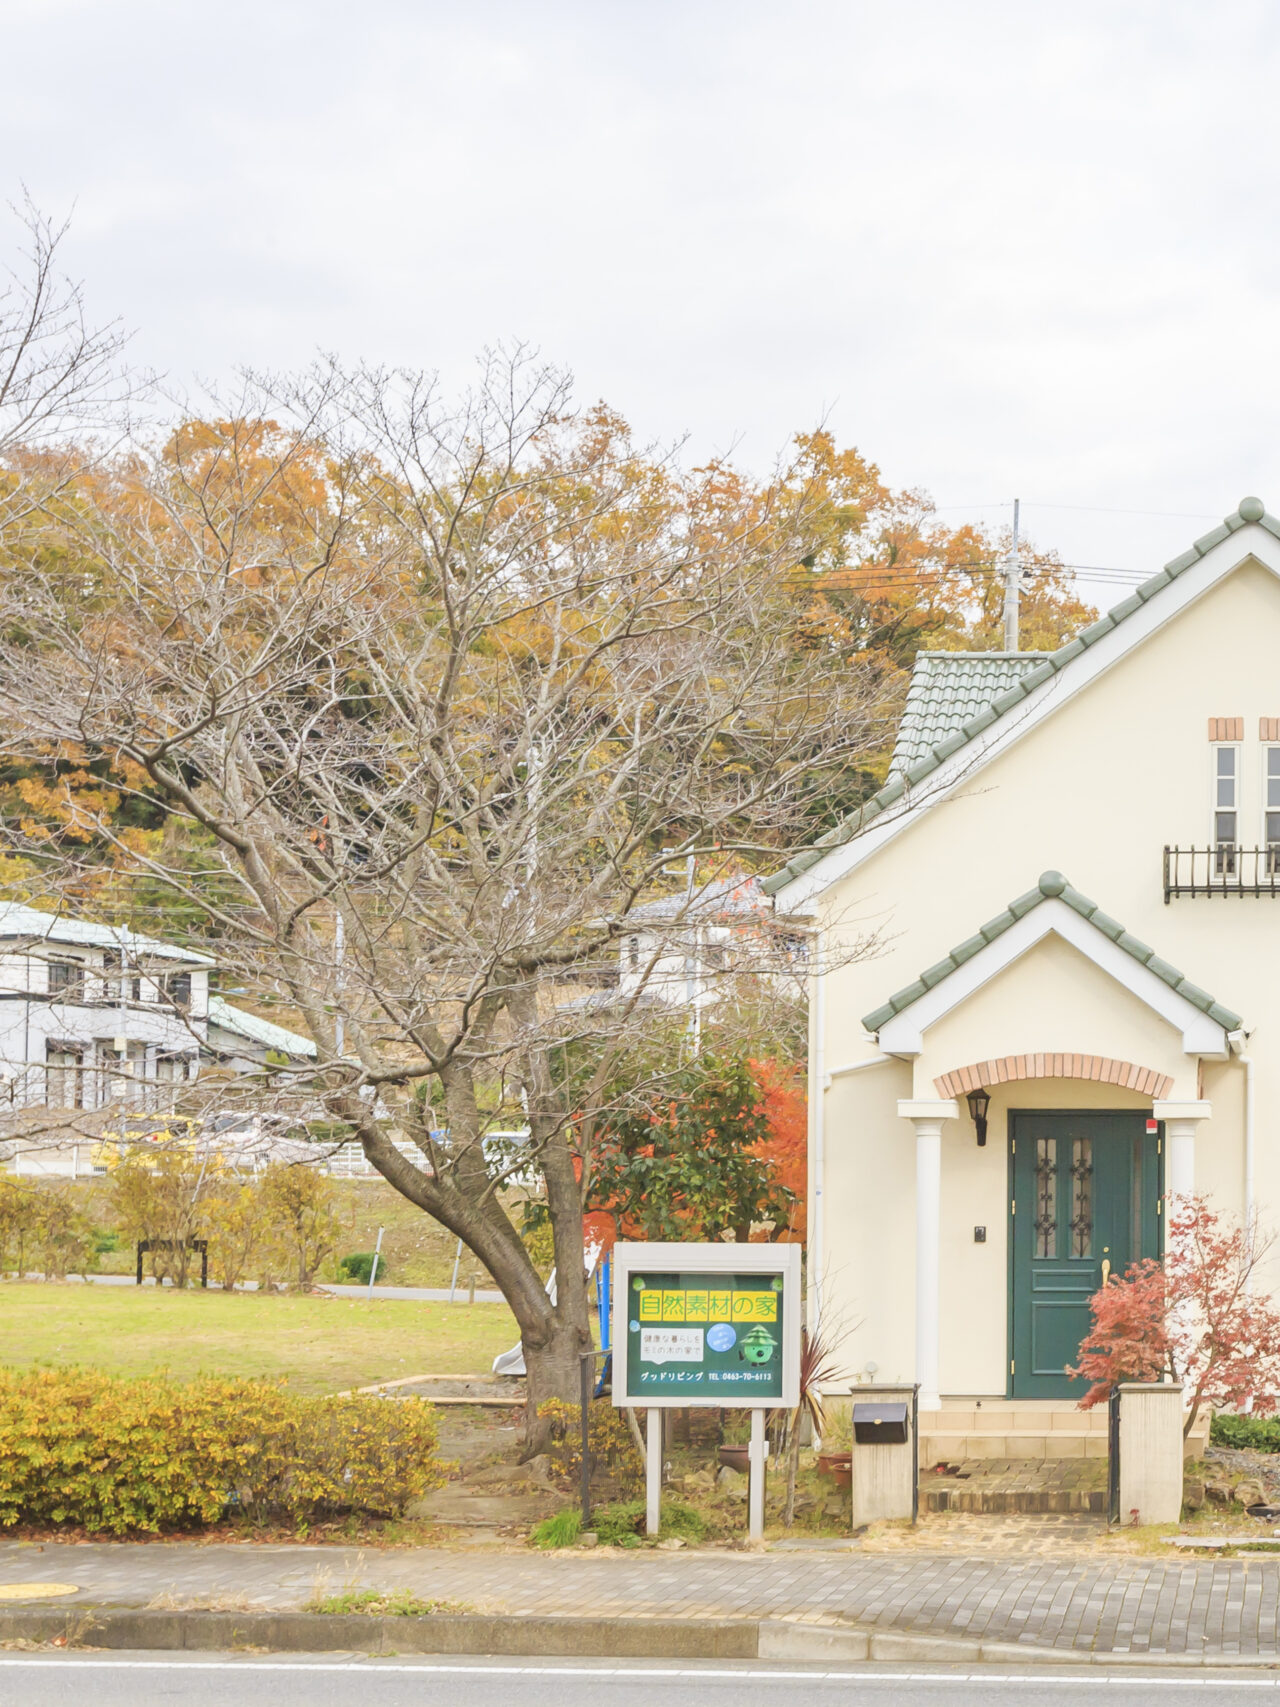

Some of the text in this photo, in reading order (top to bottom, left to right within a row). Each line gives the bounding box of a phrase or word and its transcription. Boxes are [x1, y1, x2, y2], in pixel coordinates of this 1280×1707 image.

[642, 1295, 776, 1316] 自然素材の家
[641, 1371, 703, 1381] グッドリビング
